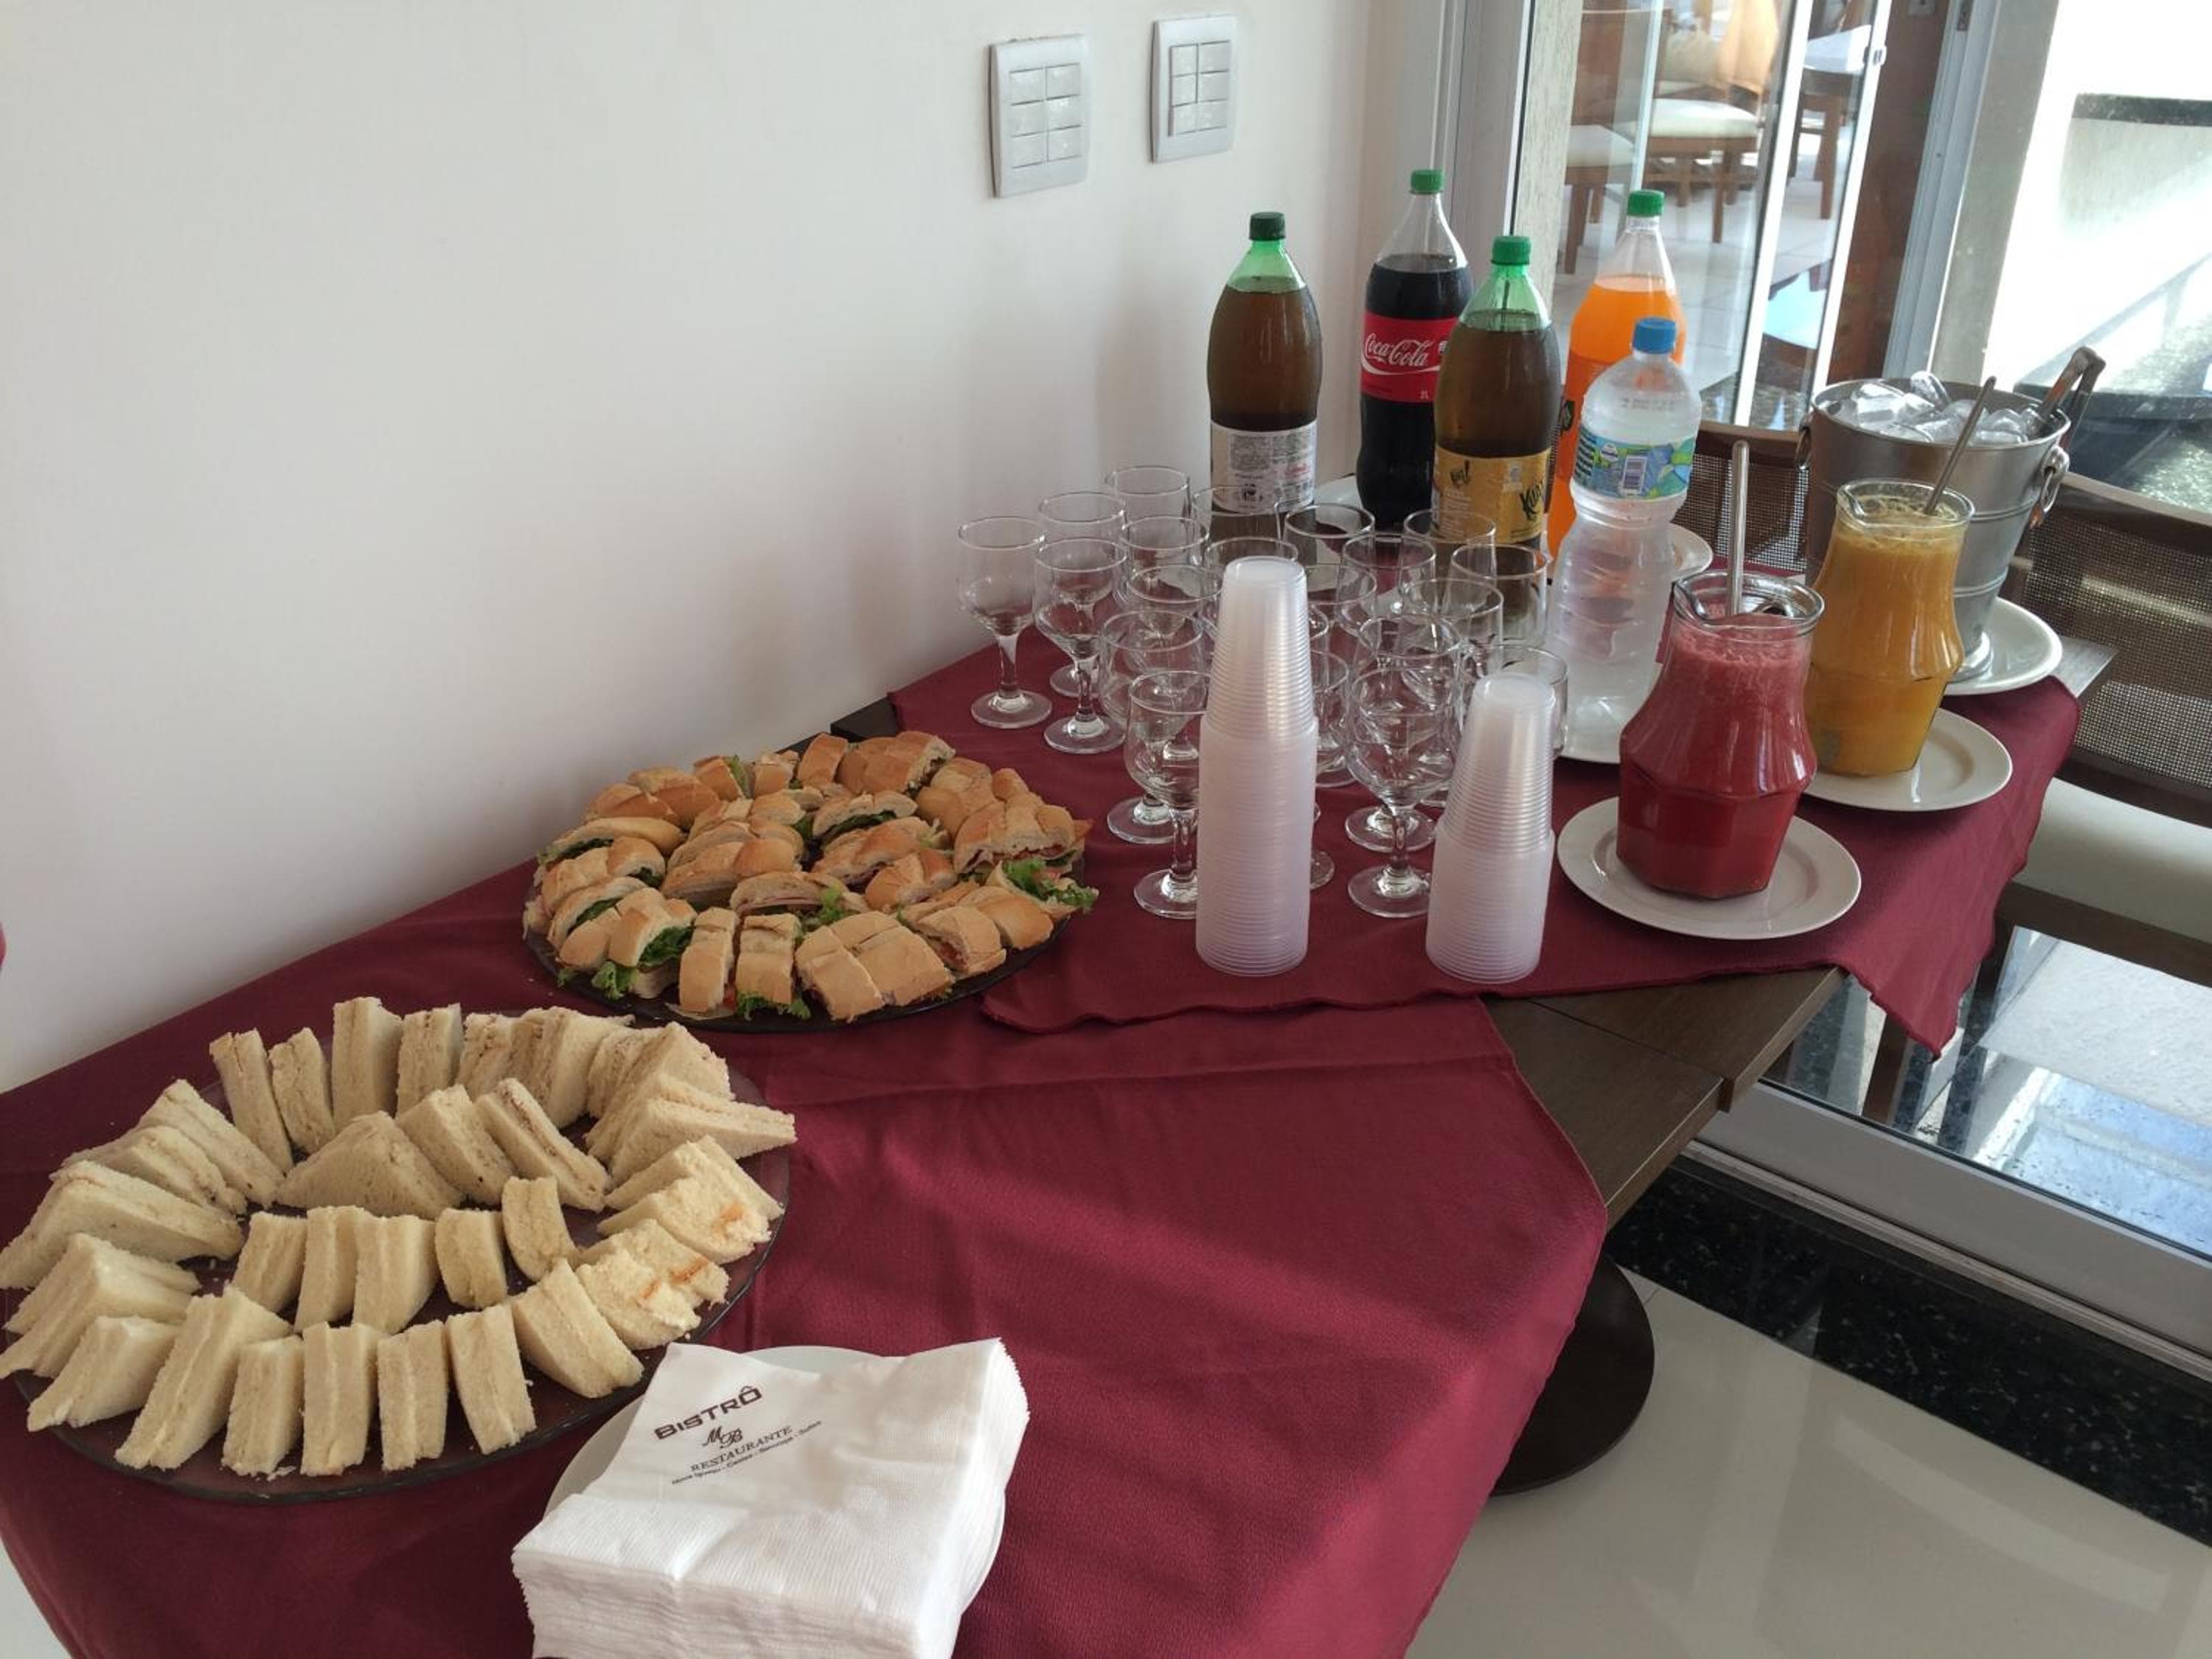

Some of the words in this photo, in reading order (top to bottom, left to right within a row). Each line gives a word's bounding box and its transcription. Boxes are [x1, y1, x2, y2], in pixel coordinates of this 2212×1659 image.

[1365, 333, 1435, 367] Coca-Cola
[653, 1385, 763, 1440] BISTRÔ
[690, 1425, 793, 1472] RESTAURANTE
